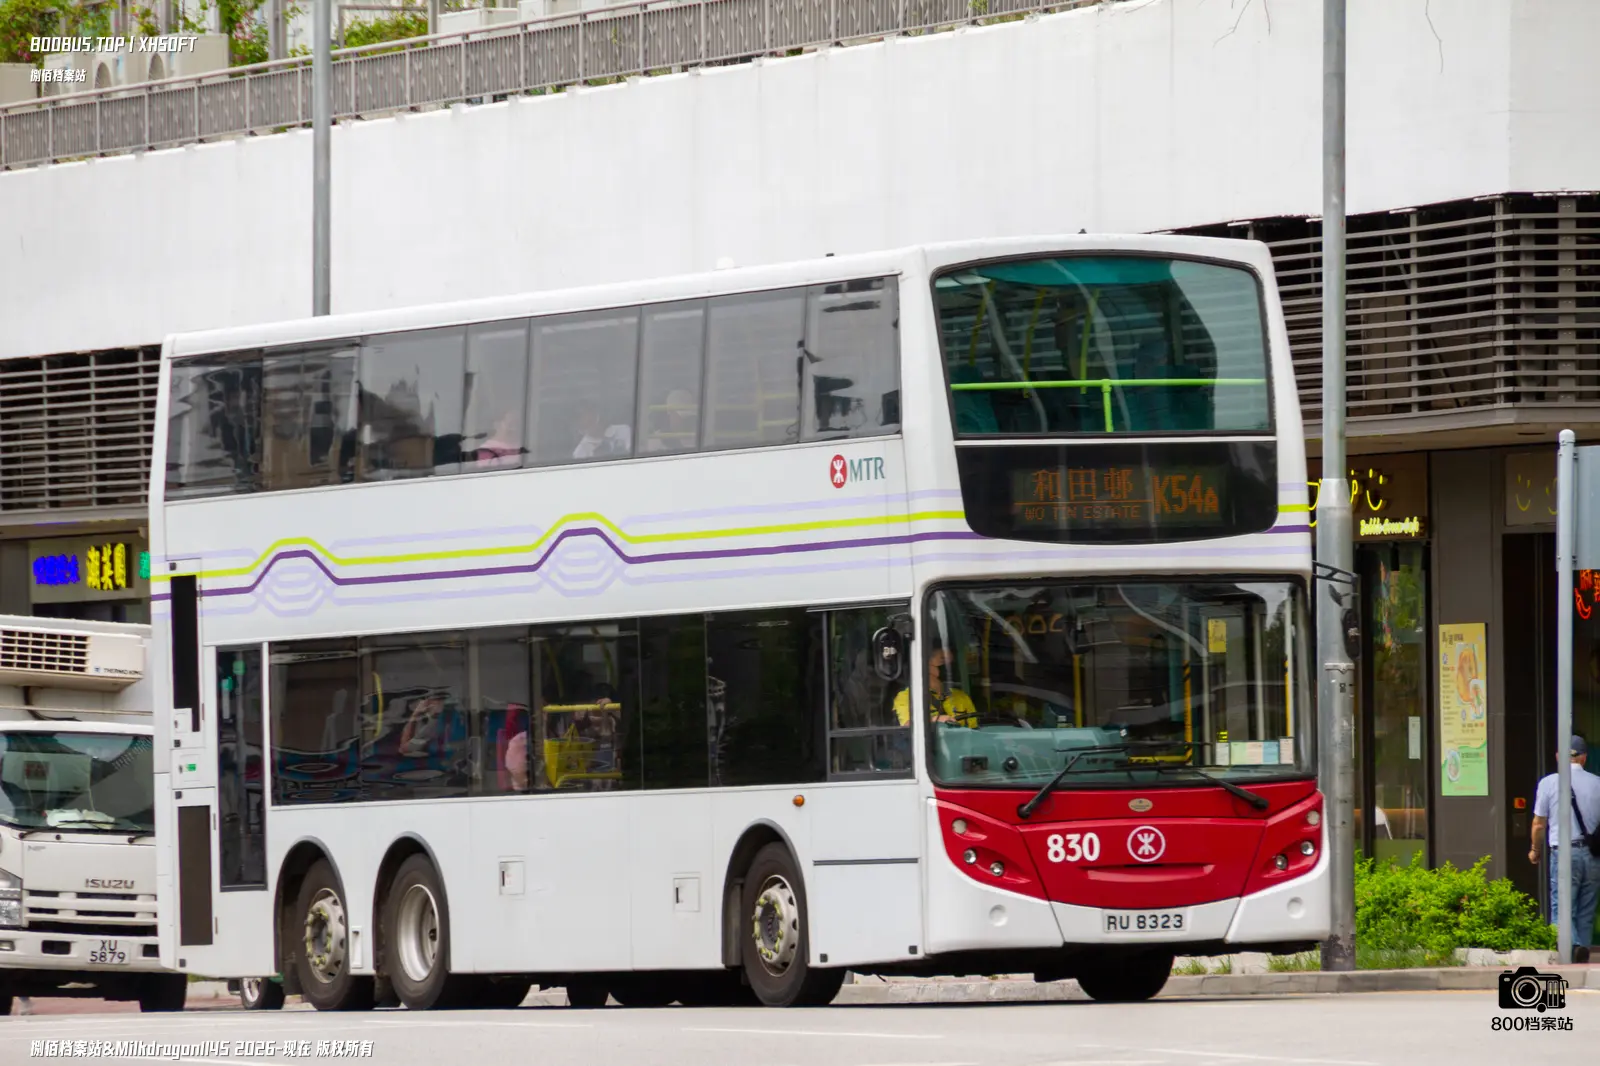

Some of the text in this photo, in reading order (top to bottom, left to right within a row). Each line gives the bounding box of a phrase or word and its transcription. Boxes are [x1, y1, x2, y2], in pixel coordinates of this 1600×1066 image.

[849, 456, 886, 482] MTR
[1025, 506, 1045, 520] WO
[1083, 505, 1141, 519] ESTATE
[1046, 832, 1101, 863] 830
[85, 878, 135, 890] ISUZU
[1107, 914, 1184, 931] RU 8323
[100, 939, 118, 951] XU
[89, 951, 126, 963] 5879
